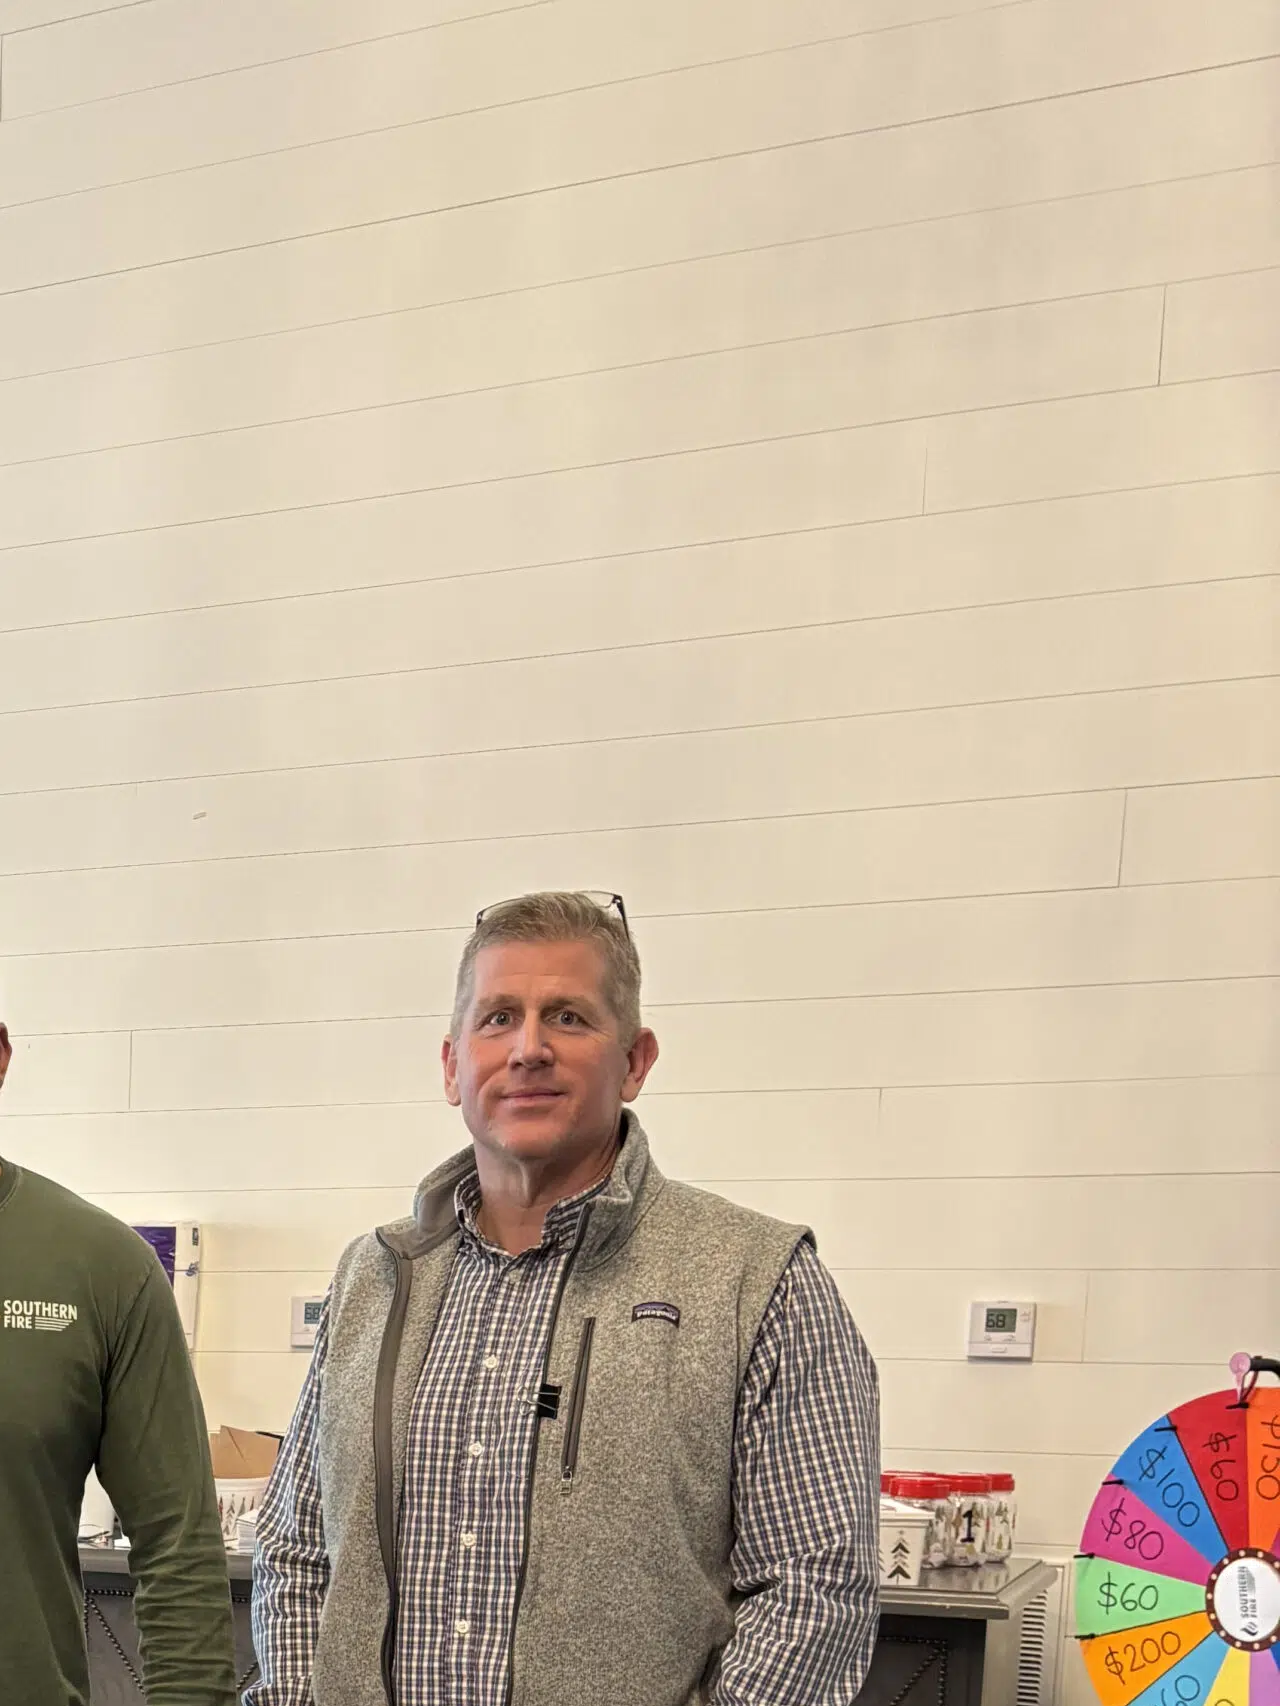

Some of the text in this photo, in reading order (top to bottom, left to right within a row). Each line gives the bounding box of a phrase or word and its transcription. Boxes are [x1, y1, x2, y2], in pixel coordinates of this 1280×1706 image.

[3, 1299, 78, 1321] SOUTHERN
[3, 1315, 33, 1329] FIRE
[1138, 1445, 1200, 1527] $100
[1202, 1432, 1239, 1501] $60
[960, 1509, 975, 1543] 1
[1101, 1498, 1164, 1560] $80
[1097, 1572, 1159, 1615] $60
[1237, 1566, 1248, 1619] SOUTHERN
[1249, 1598, 1257, 1619] FIRE
[1104, 1631, 1181, 1686] $200
